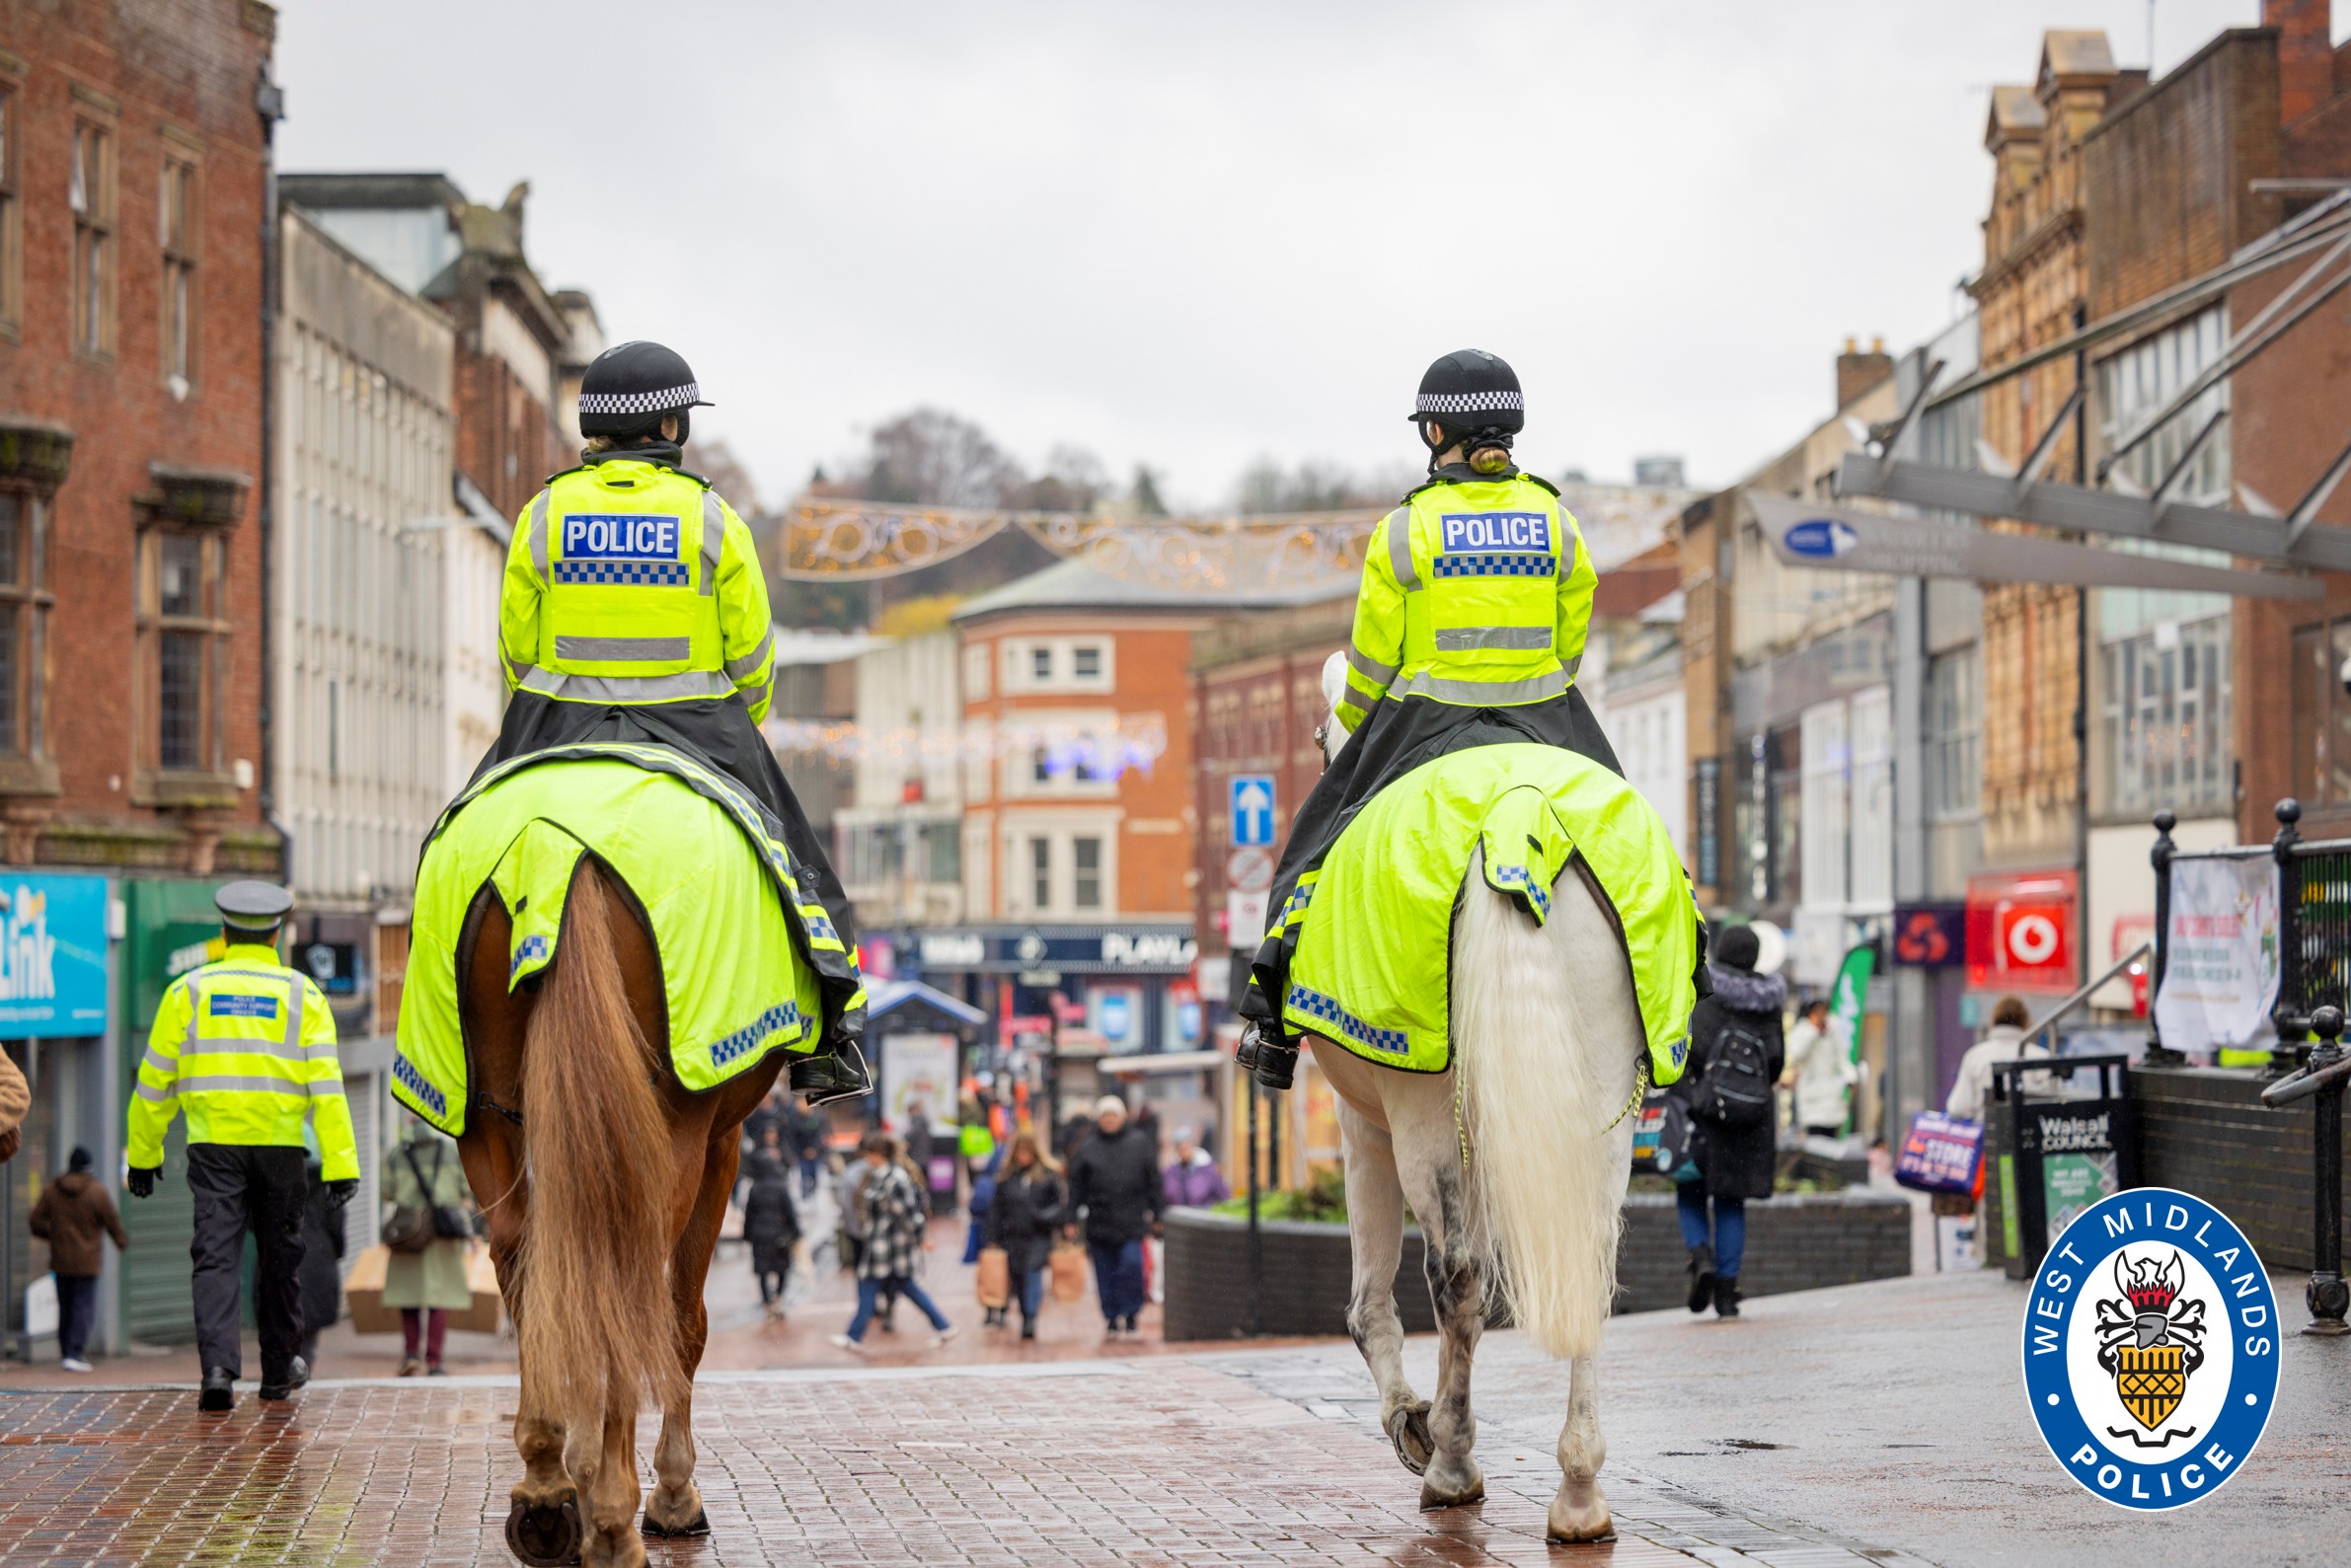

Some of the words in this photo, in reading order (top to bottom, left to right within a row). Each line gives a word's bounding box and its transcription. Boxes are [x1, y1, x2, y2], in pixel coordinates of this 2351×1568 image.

[567, 521, 674, 554] POLICE
[1446, 517, 1546, 547] POLICE
[212, 1001, 249, 1010] COMMUNITY
[249, 1002, 276, 1012] SUPPORT
[2039, 1113, 2110, 1136] Walsall
[2041, 1134, 2108, 1152] COUNCIL
